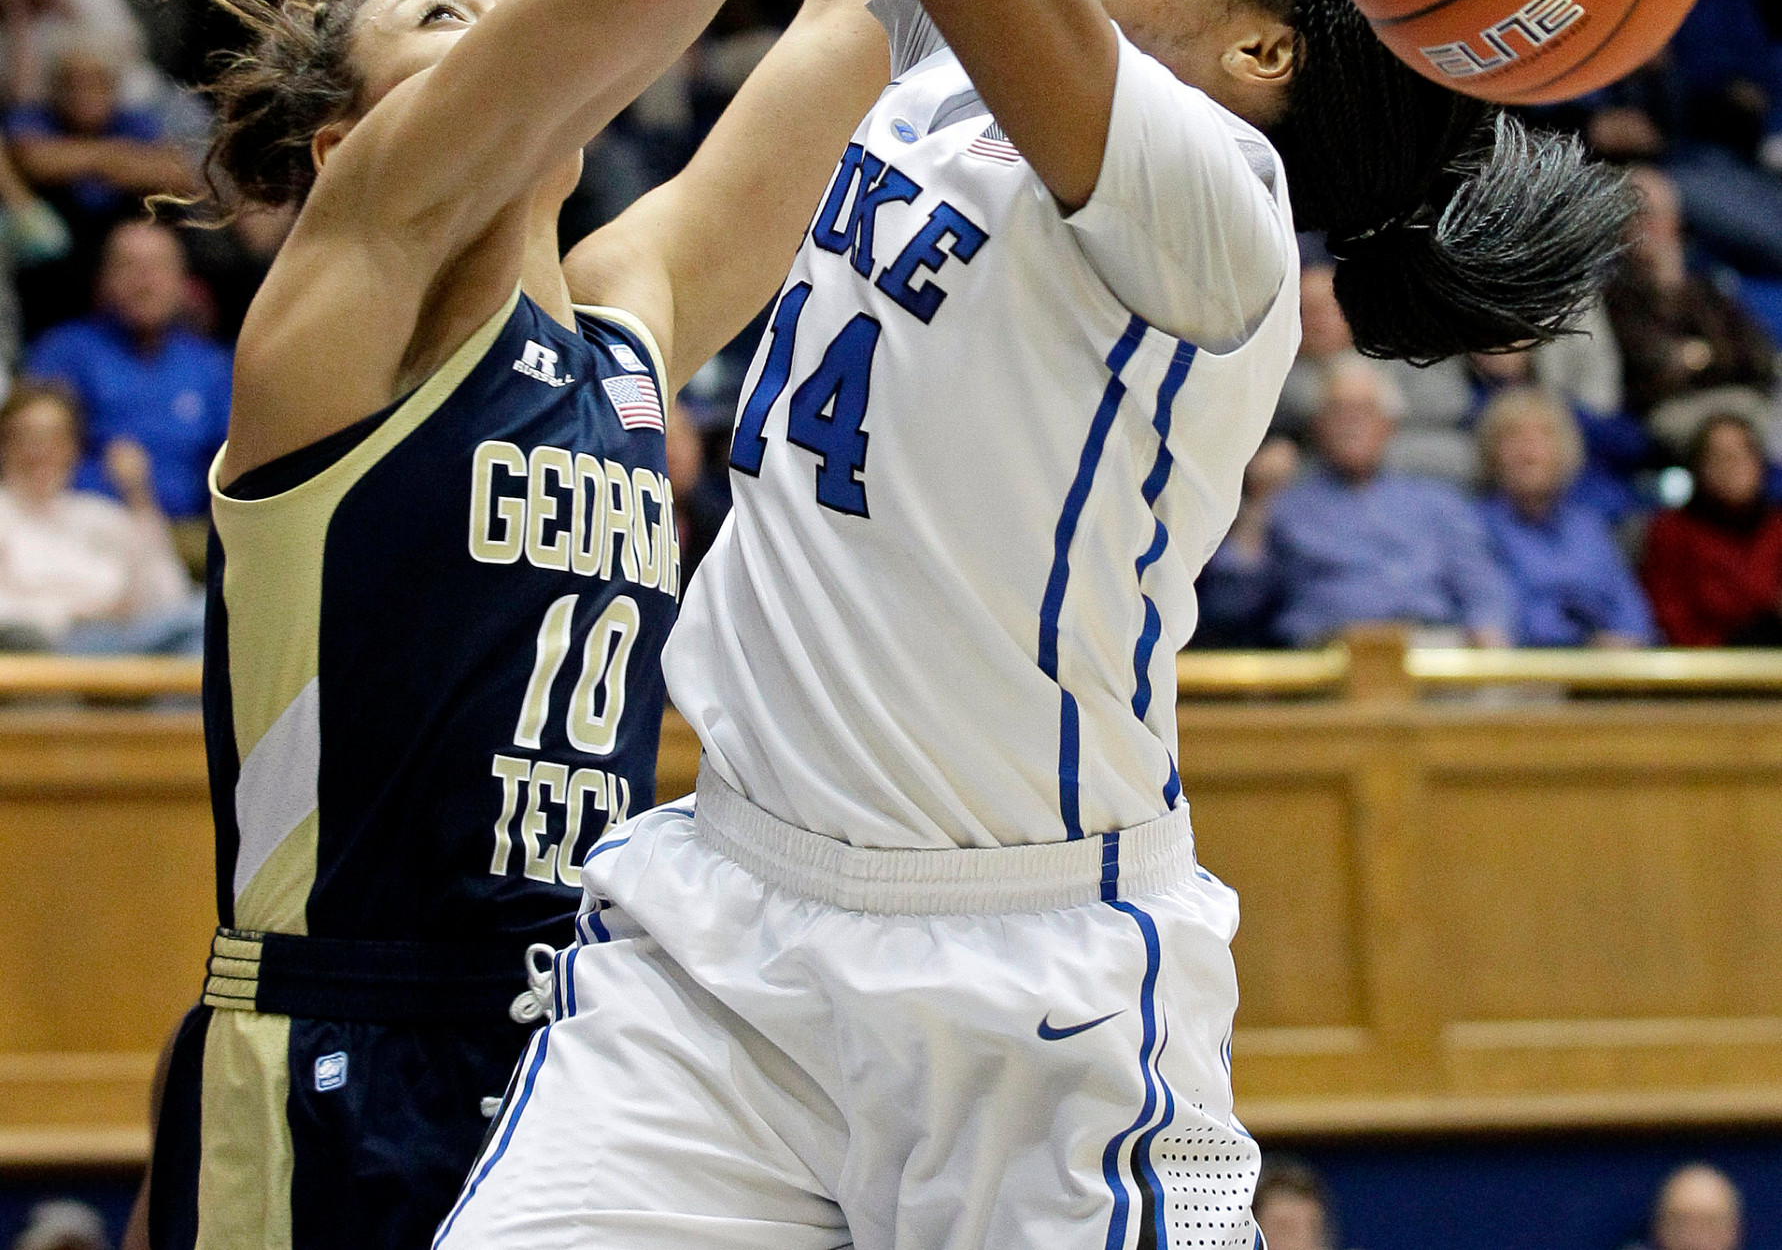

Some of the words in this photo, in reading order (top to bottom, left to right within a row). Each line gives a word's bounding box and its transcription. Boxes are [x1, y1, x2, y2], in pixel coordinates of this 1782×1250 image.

[810, 141, 990, 325] UKE
[729, 280, 882, 519] 14
[468, 440, 681, 604] GEORGIA
[513, 593, 640, 755] 10
